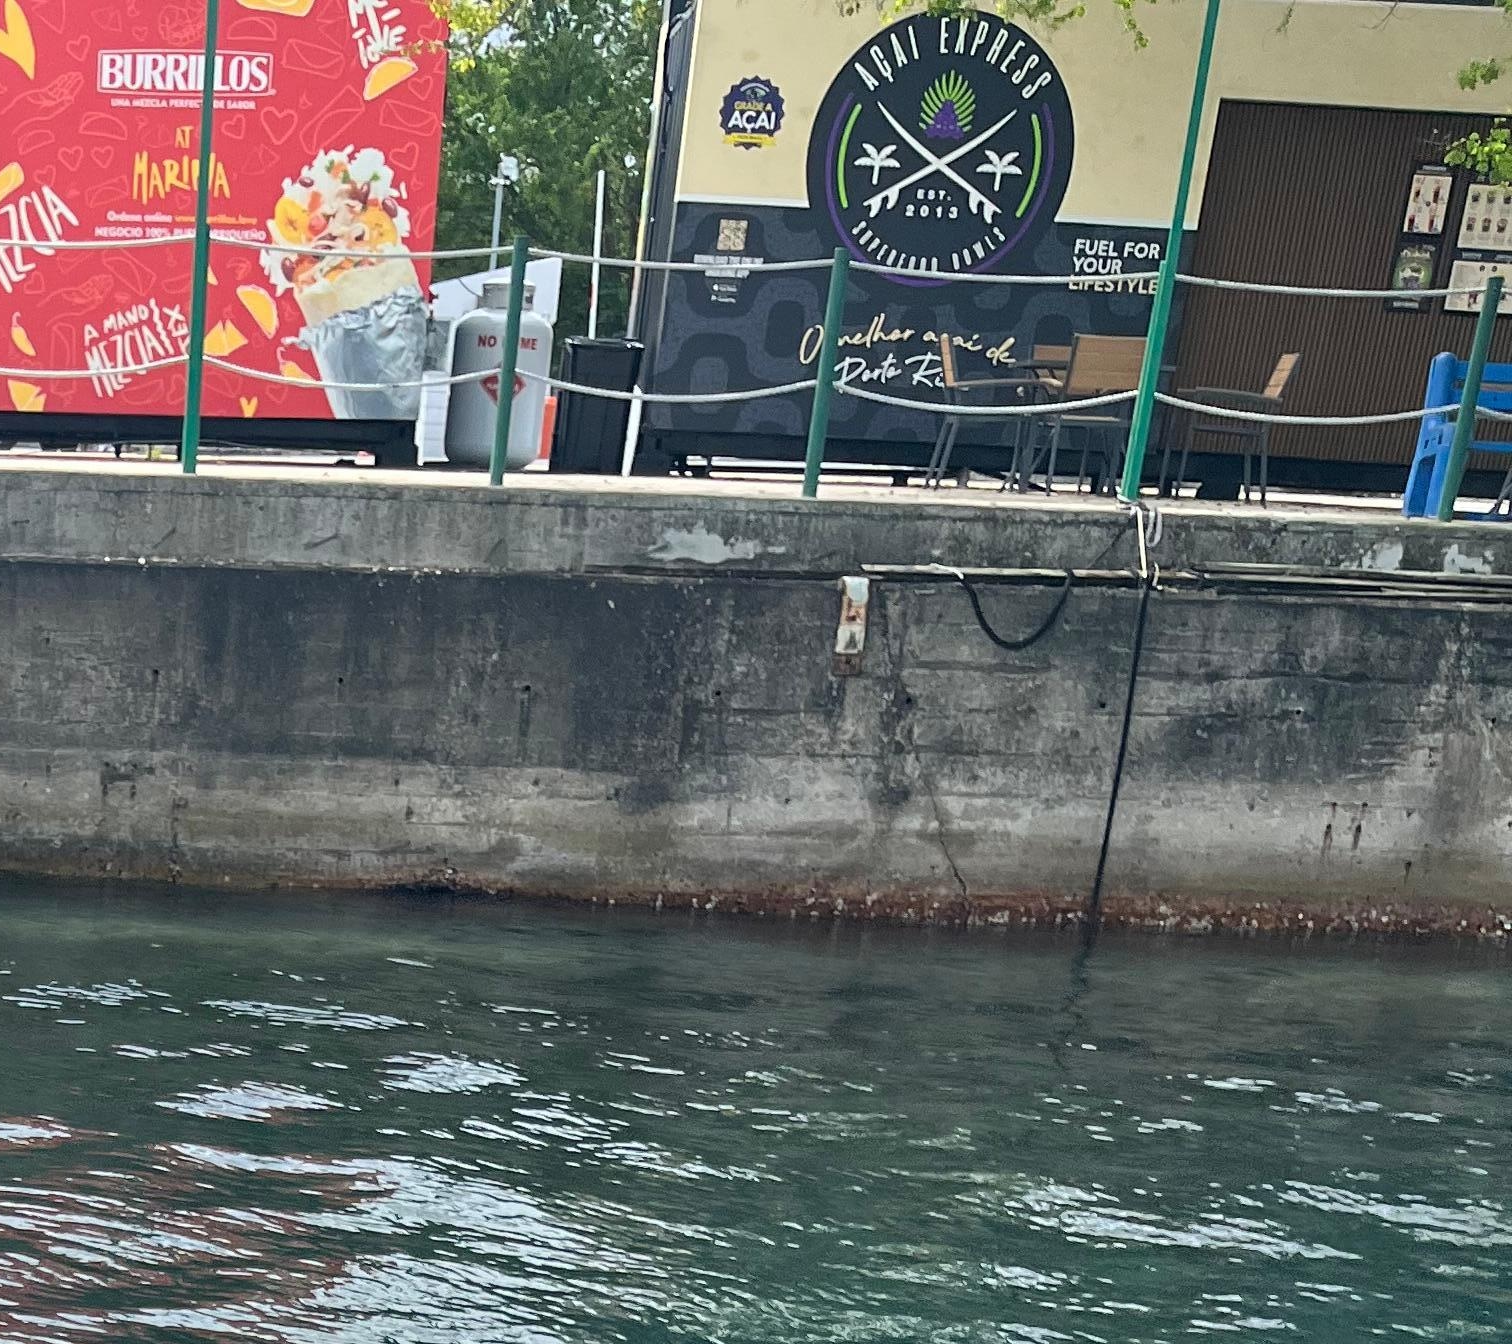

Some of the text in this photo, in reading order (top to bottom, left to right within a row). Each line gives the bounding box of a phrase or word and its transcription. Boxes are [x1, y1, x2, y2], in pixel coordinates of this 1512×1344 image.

[854, 17, 1052, 99] AÇAI EXPRESS
[728, 110, 776, 133] AÇAI
[175, 126, 193, 148] AT
[917, 189, 952, 201] EST.
[905, 205, 958, 219] 2013
[1074, 238, 1160, 259] FUEL FOR
[1073, 256, 1123, 274] YOUR
[478, 335, 496, 347] NO
